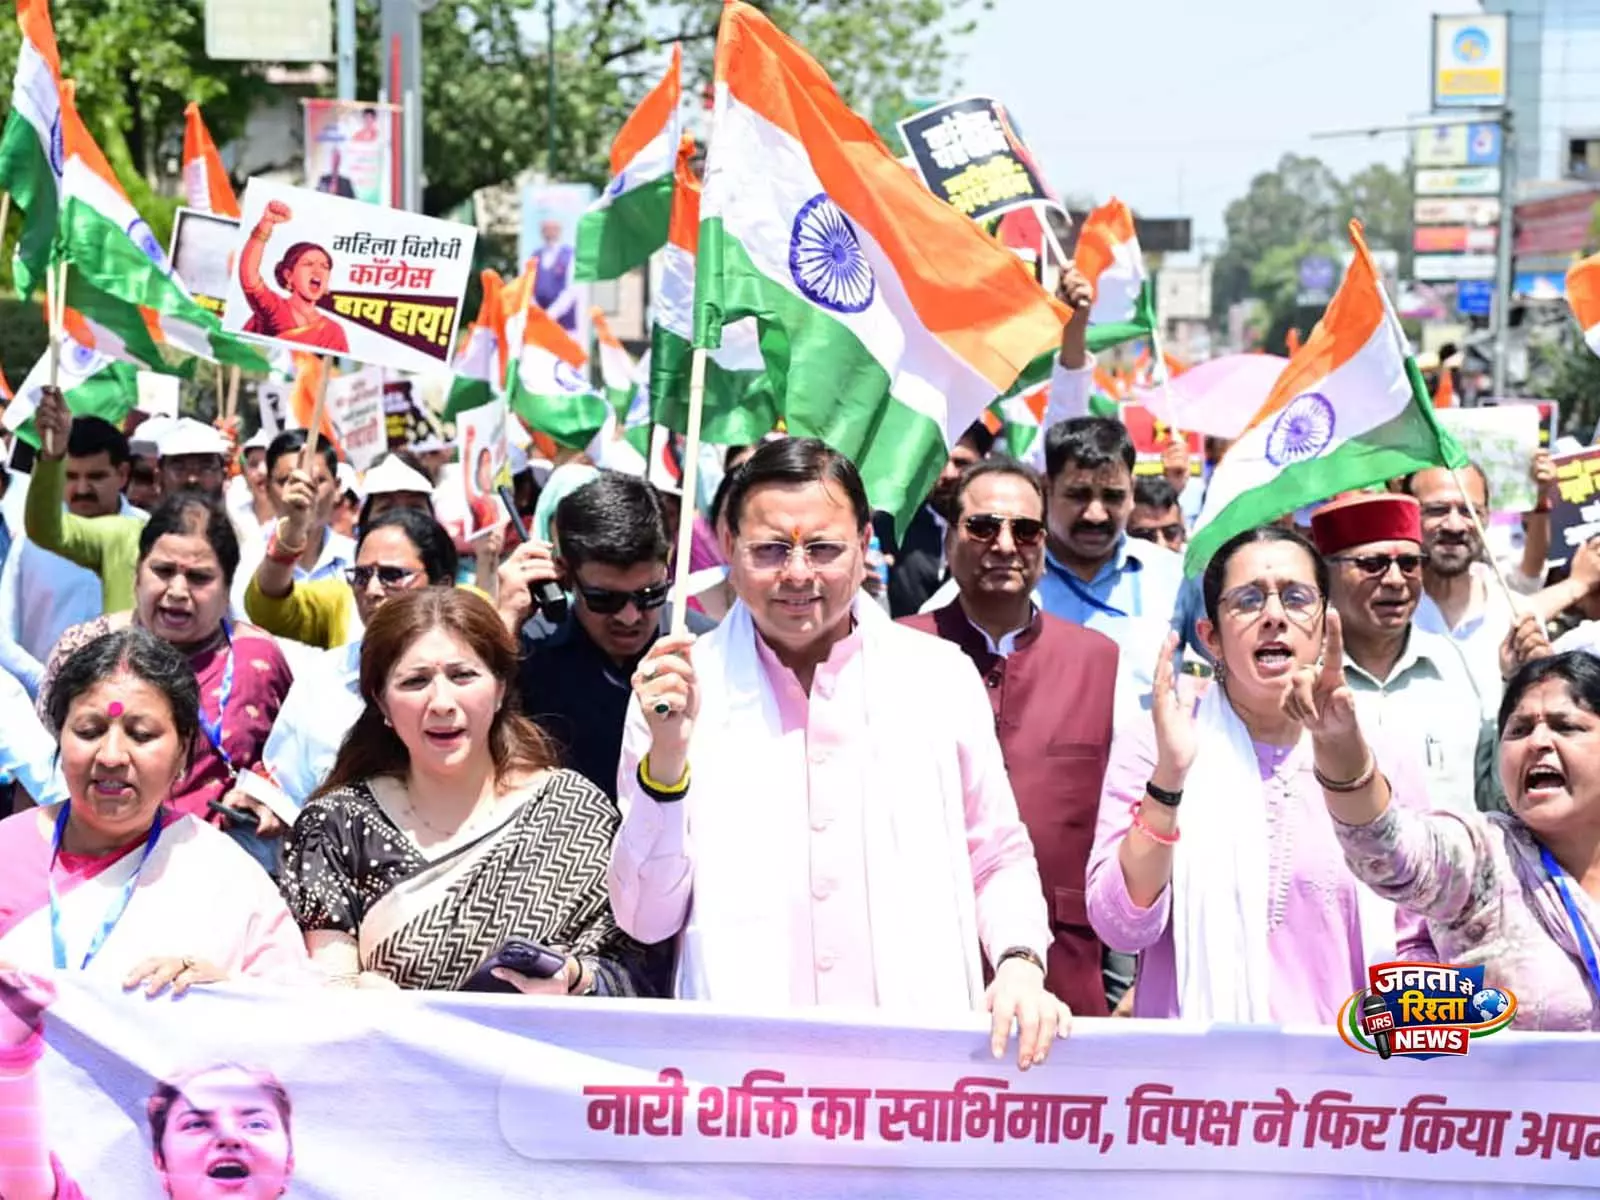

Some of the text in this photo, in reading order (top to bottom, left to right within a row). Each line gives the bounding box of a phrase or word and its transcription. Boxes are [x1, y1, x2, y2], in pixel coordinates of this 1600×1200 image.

[333, 232, 462, 260] महिला विरोधी
[390, 300, 455, 346] हाय!
[583, 1067, 689, 1136] नारी
[697, 1069, 803, 1139] शक्ति
[807, 1088, 872, 1141] का
[875, 1076, 1115, 1154] स्वाभिमान,
[1125, 1083, 1248, 1147] विपक्ष
[1252, 1088, 1300, 1147] ने
[1303, 1090, 1397, 1151] फिर
[1399, 1095, 1512, 1158] किया
